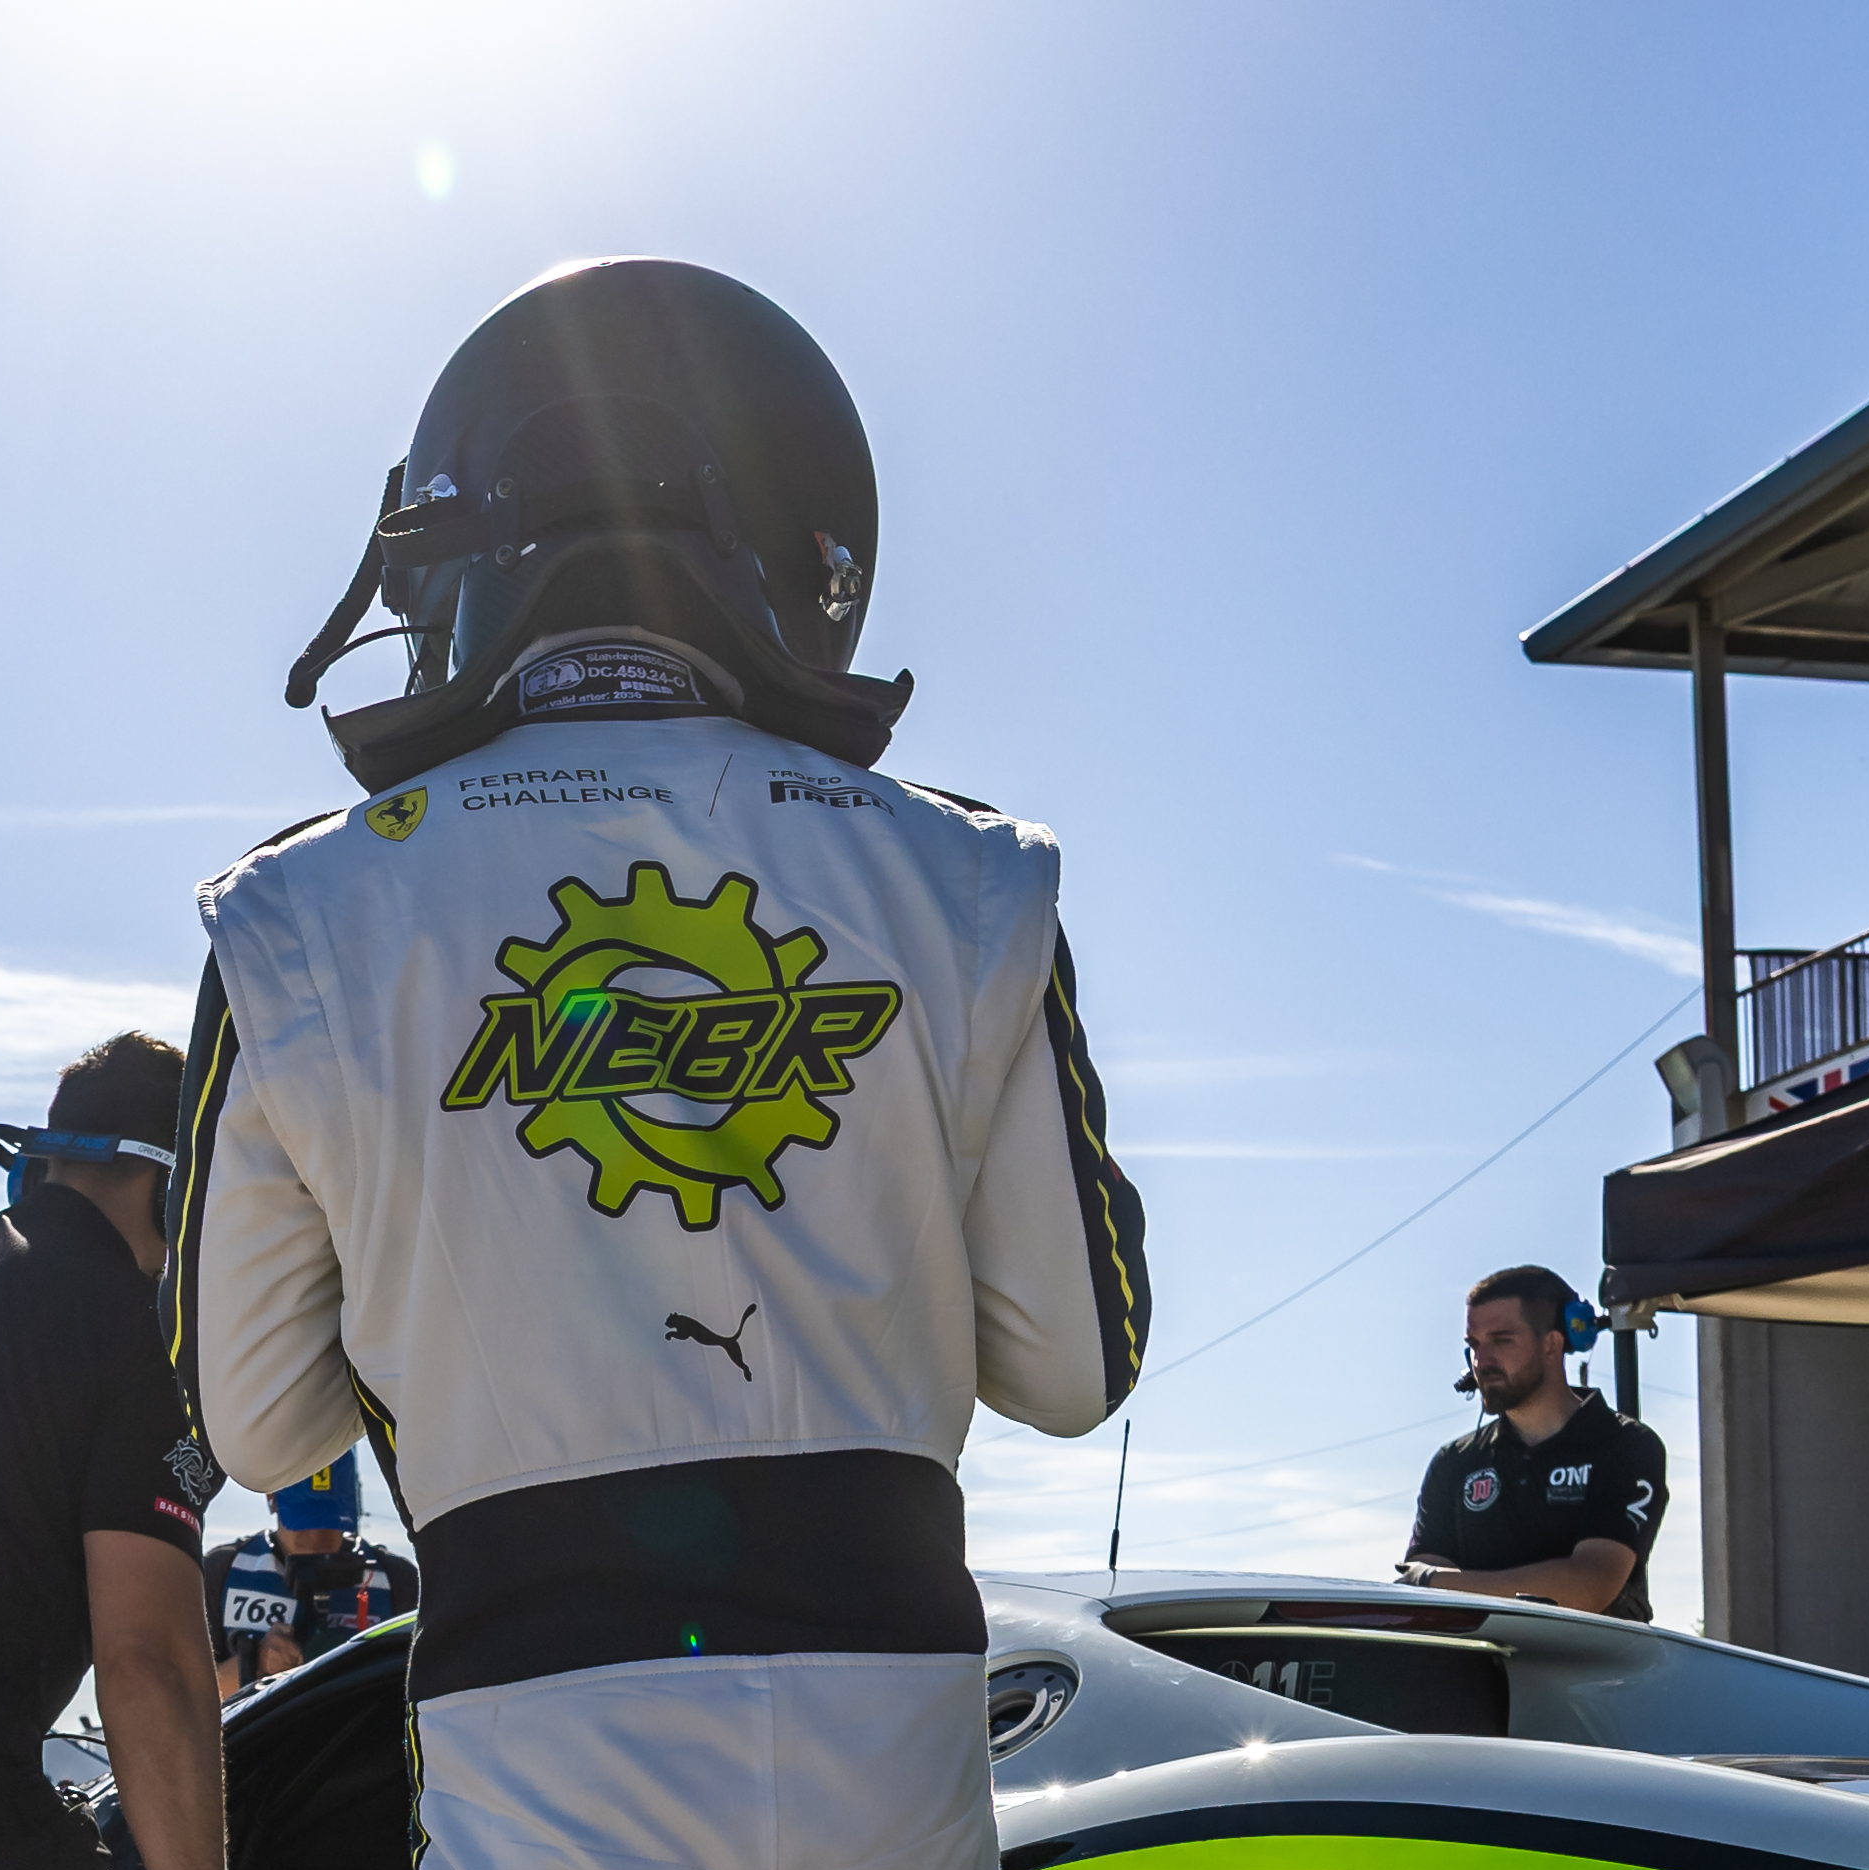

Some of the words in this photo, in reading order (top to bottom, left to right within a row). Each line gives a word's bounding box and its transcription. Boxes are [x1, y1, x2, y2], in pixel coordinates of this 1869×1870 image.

[549, 694, 576, 706] valid
[459, 769, 607, 791] FERRARI
[767, 769, 841, 785] TROFEO
[461, 786, 673, 810] CHALLENGE
[440, 979, 904, 1112] NEBR
[138, 1144, 164, 1158] CREW
[164, 1153, 171, 1161] 2
[159, 1500, 178, 1515] BAE
[232, 1595, 288, 1627] 768
